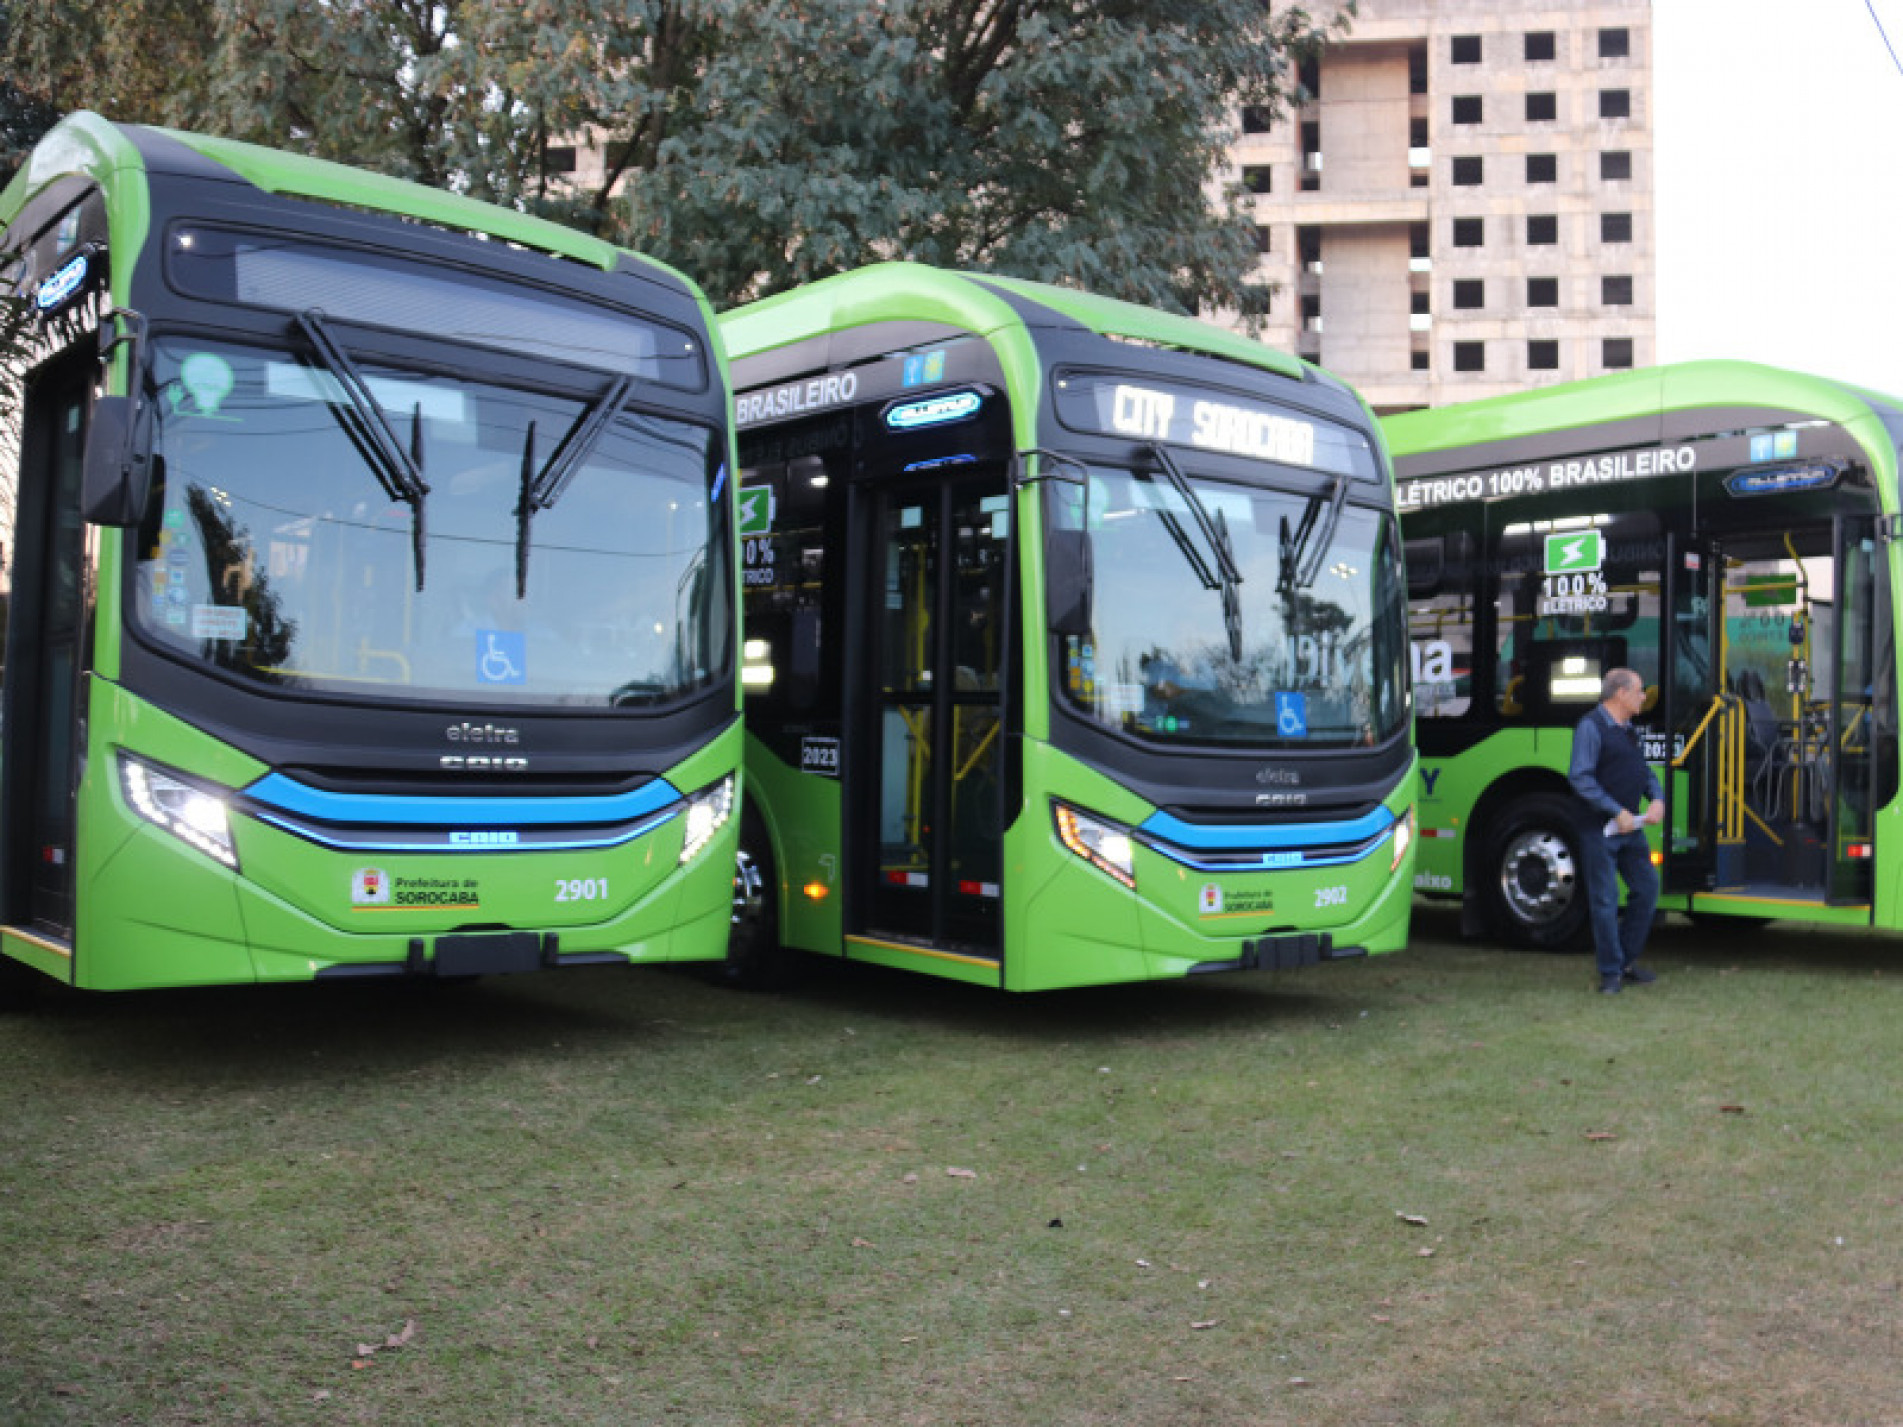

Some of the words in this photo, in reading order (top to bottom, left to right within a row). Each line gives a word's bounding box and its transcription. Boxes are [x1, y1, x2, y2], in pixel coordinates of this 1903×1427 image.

[736, 372, 857, 423] BRASILEIRO
[1113, 385, 1174, 438] CITY
[1191, 400, 1315, 465] SOROCABA
[1489, 467, 1543, 494] 100%
[1550, 446, 1696, 484] BRASILEIRO
[1544, 571, 1607, 598] 100%
[395, 877, 460, 889] Prefeitura
[463, 877, 479, 888] de
[555, 878, 608, 901] 2901
[395, 891, 479, 905] SOROCABA
